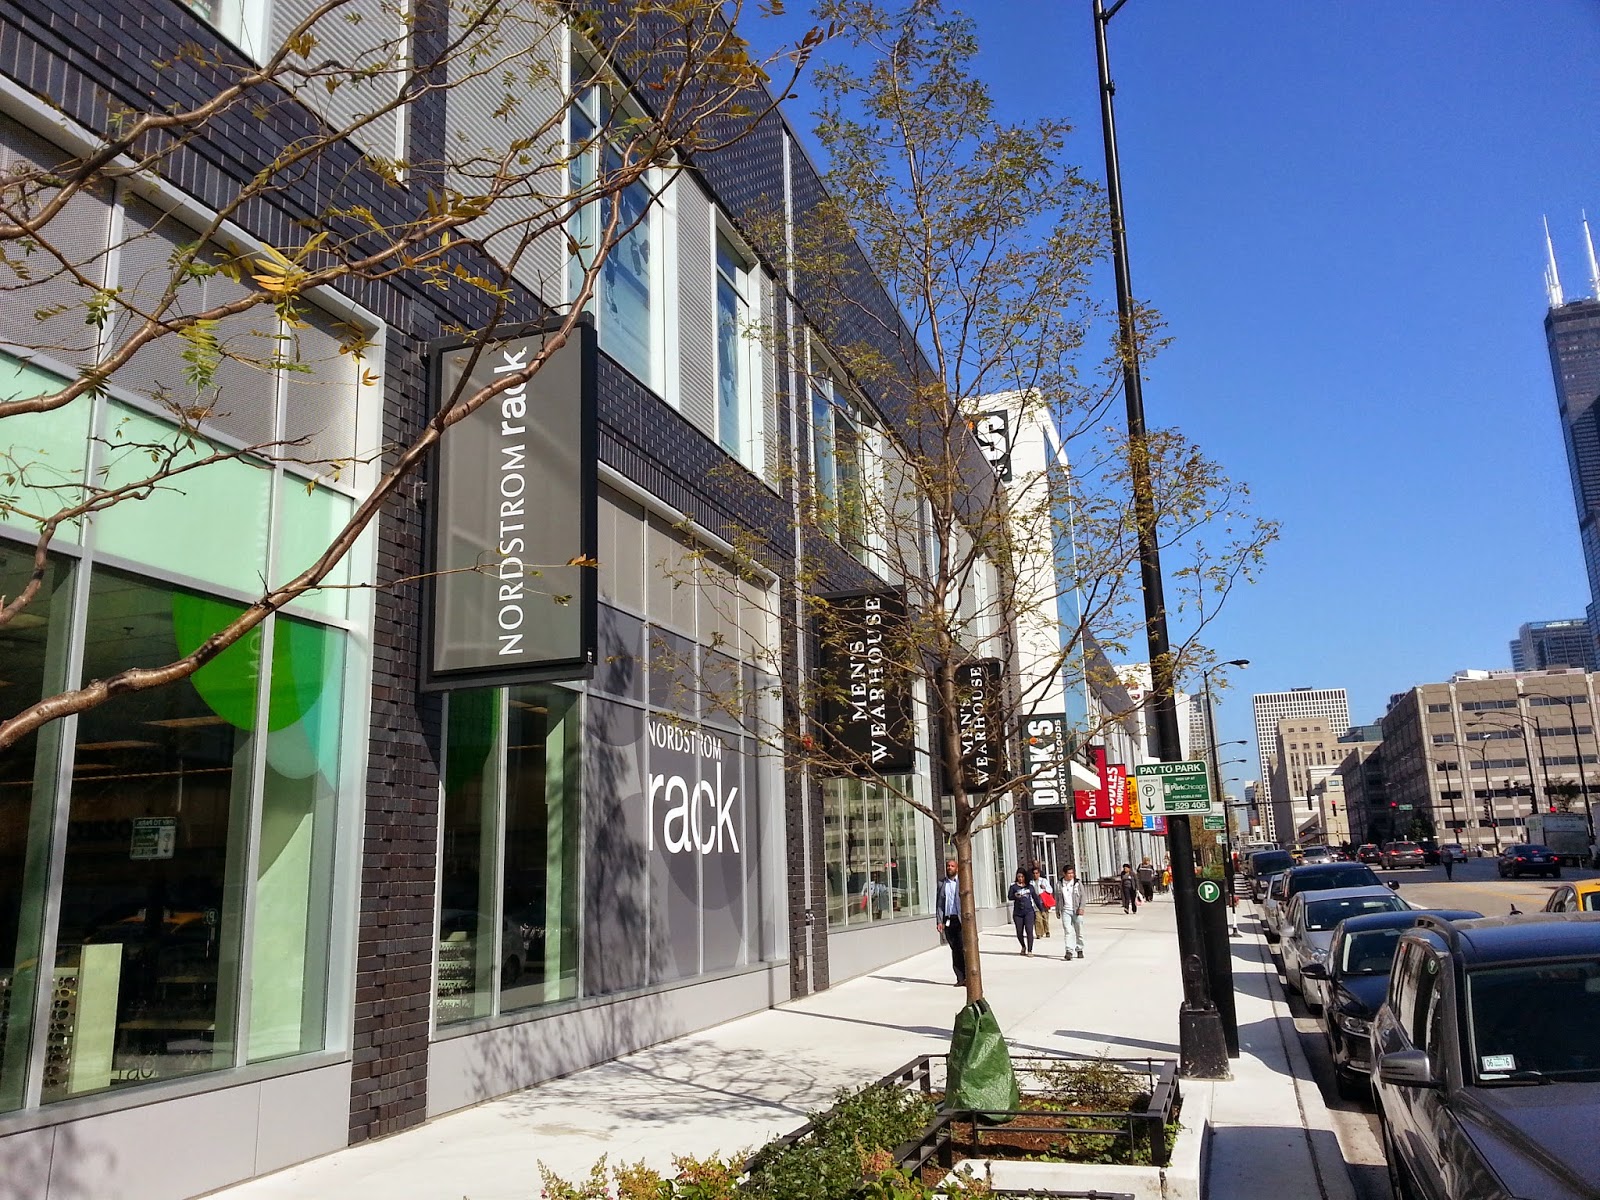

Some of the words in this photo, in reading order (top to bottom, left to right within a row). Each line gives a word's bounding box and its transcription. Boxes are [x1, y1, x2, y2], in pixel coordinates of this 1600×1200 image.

[499, 444, 526, 656] NORDSTROM
[850, 640, 868, 722] MEN'S
[865, 597, 888, 764] WEARHOUSE
[648, 721, 722, 761] NORDSTROM
[970, 666, 990, 786] WEARHOUSE
[1055, 719, 1063, 753] GOODS
[1027, 719, 1060, 806] DICK'S
[1057, 753, 1068, 805] SPORTING
[1140, 766, 1157, 775] PAY
[1159, 765, 1173, 773] TO
[1174, 763, 1201, 773] PARK
[648, 761, 740, 855] rack
[1116, 775, 1126, 806] COMPANY
[1175, 802, 1190, 810] 529
[1191, 801, 1207, 809] 406
[1204, 884, 1214, 899] P
